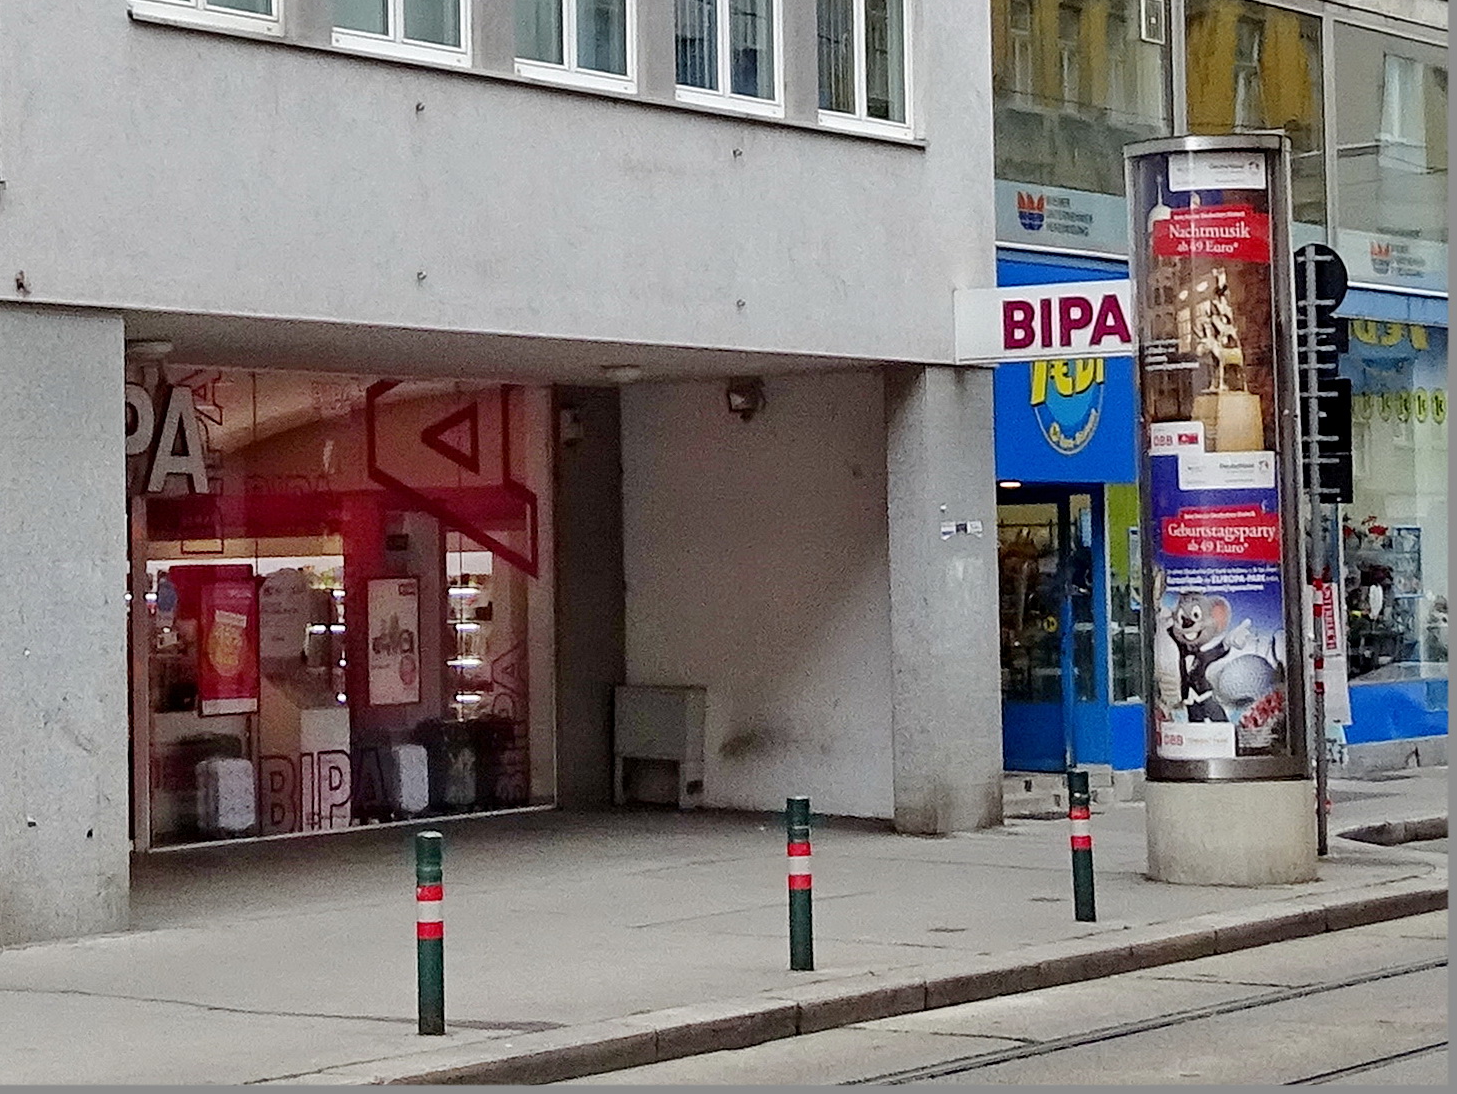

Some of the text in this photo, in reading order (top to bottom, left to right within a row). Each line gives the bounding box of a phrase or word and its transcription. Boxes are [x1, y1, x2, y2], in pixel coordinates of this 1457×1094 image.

[1168, 221, 1251, 239] Nachtmusik
[1177, 241, 1189, 253] ab
[1002, 294, 1132, 350] BIPA
[1168, 523, 1276, 543] Geburtstagsparty
[1200, 540, 1214, 553] 49
